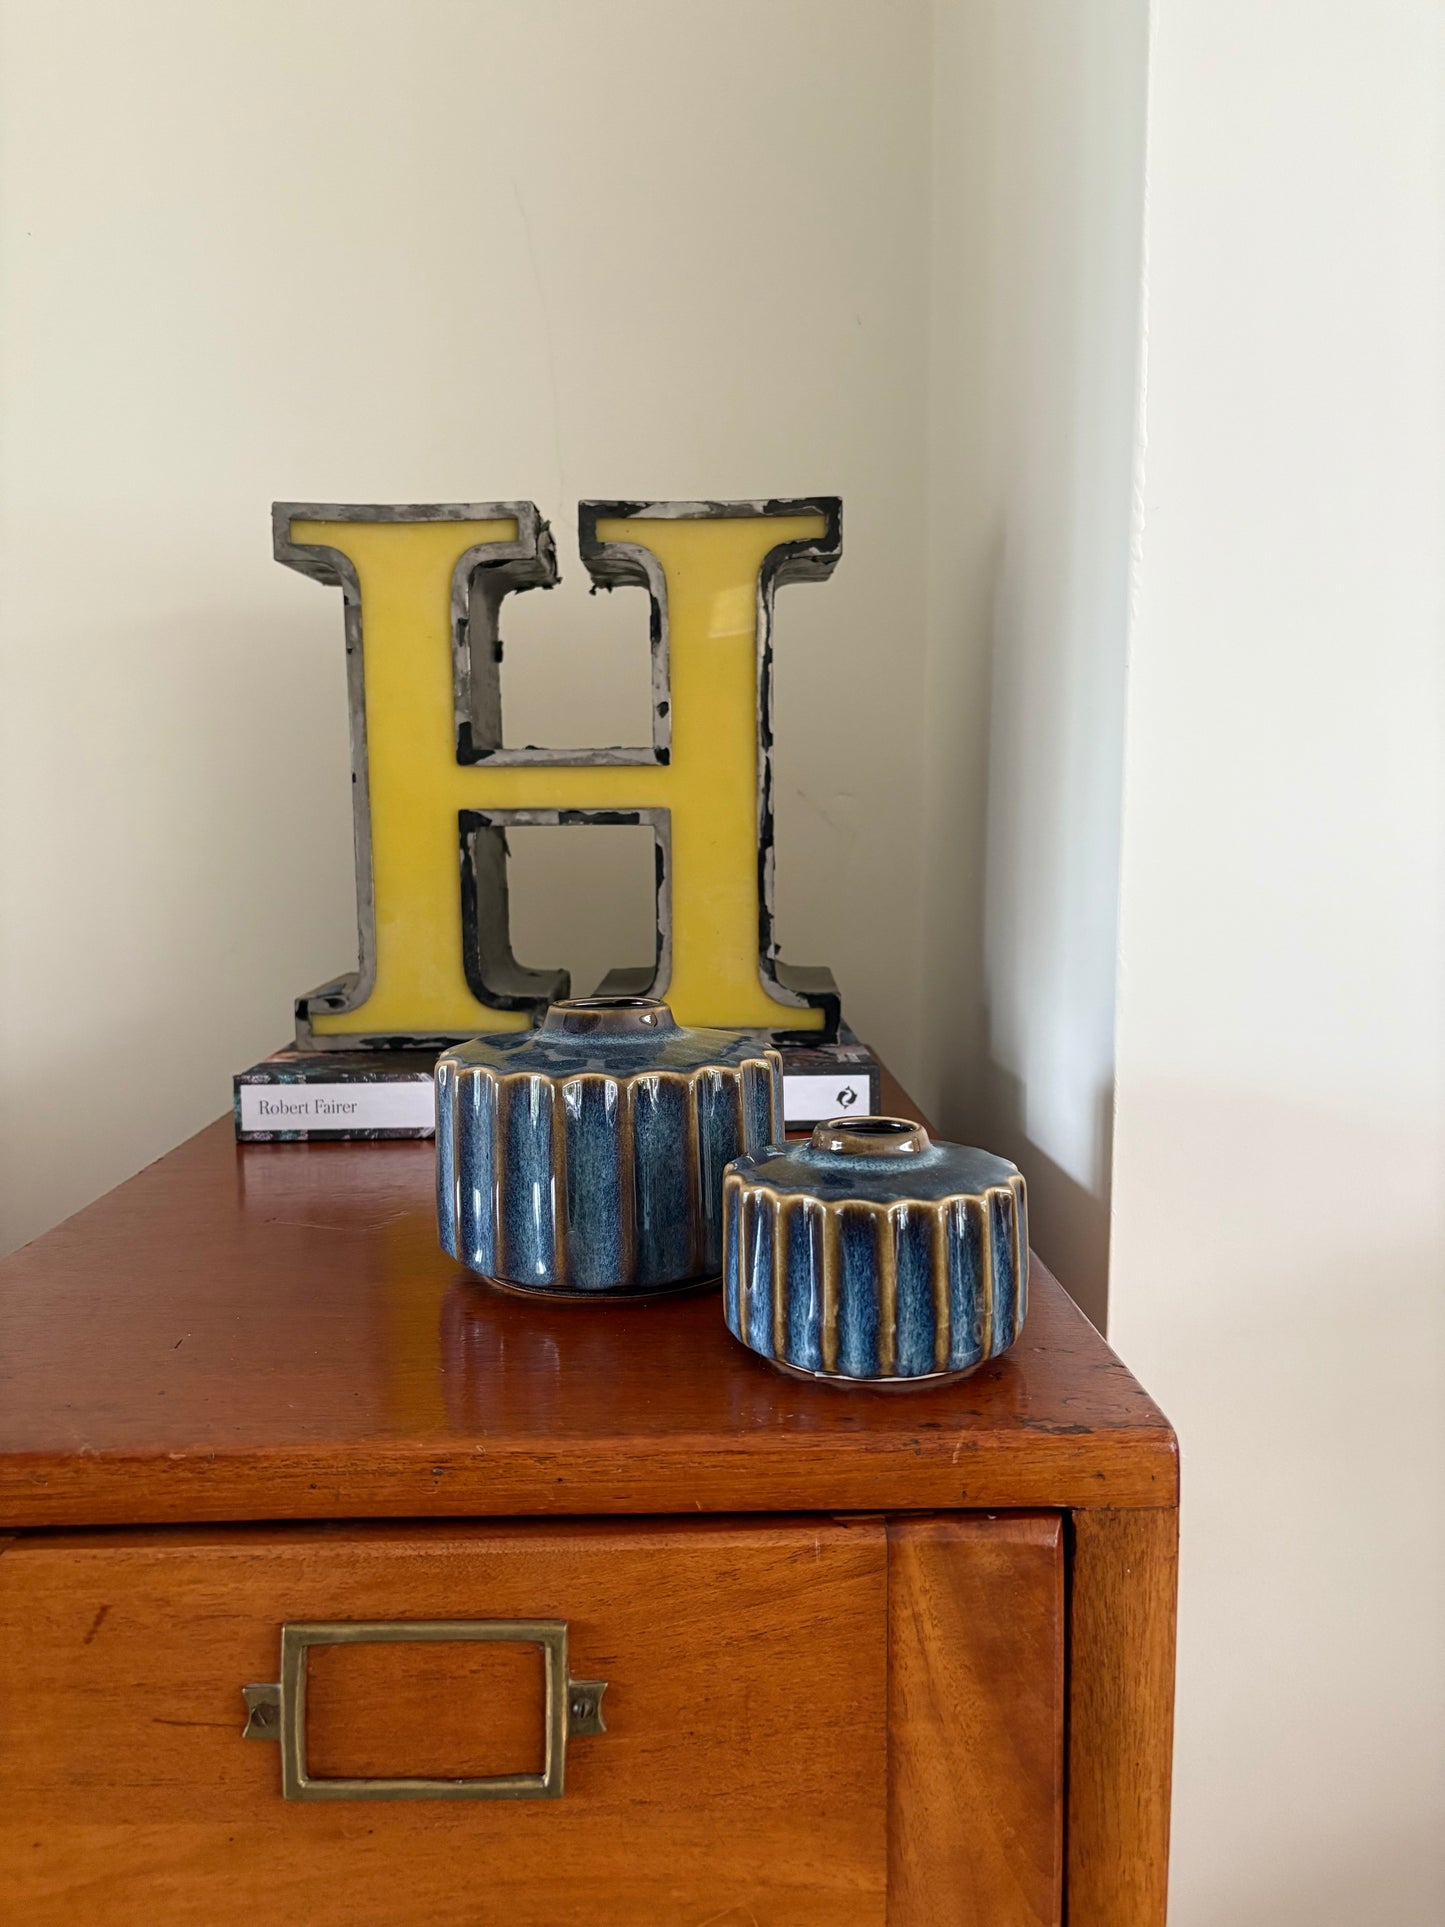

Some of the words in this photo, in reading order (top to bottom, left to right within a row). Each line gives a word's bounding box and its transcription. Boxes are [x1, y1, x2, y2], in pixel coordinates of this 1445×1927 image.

[273, 498, 842, 1051] H
[259, 1099, 309, 1116] Robert
[315, 1098, 358, 1115] Fairer
